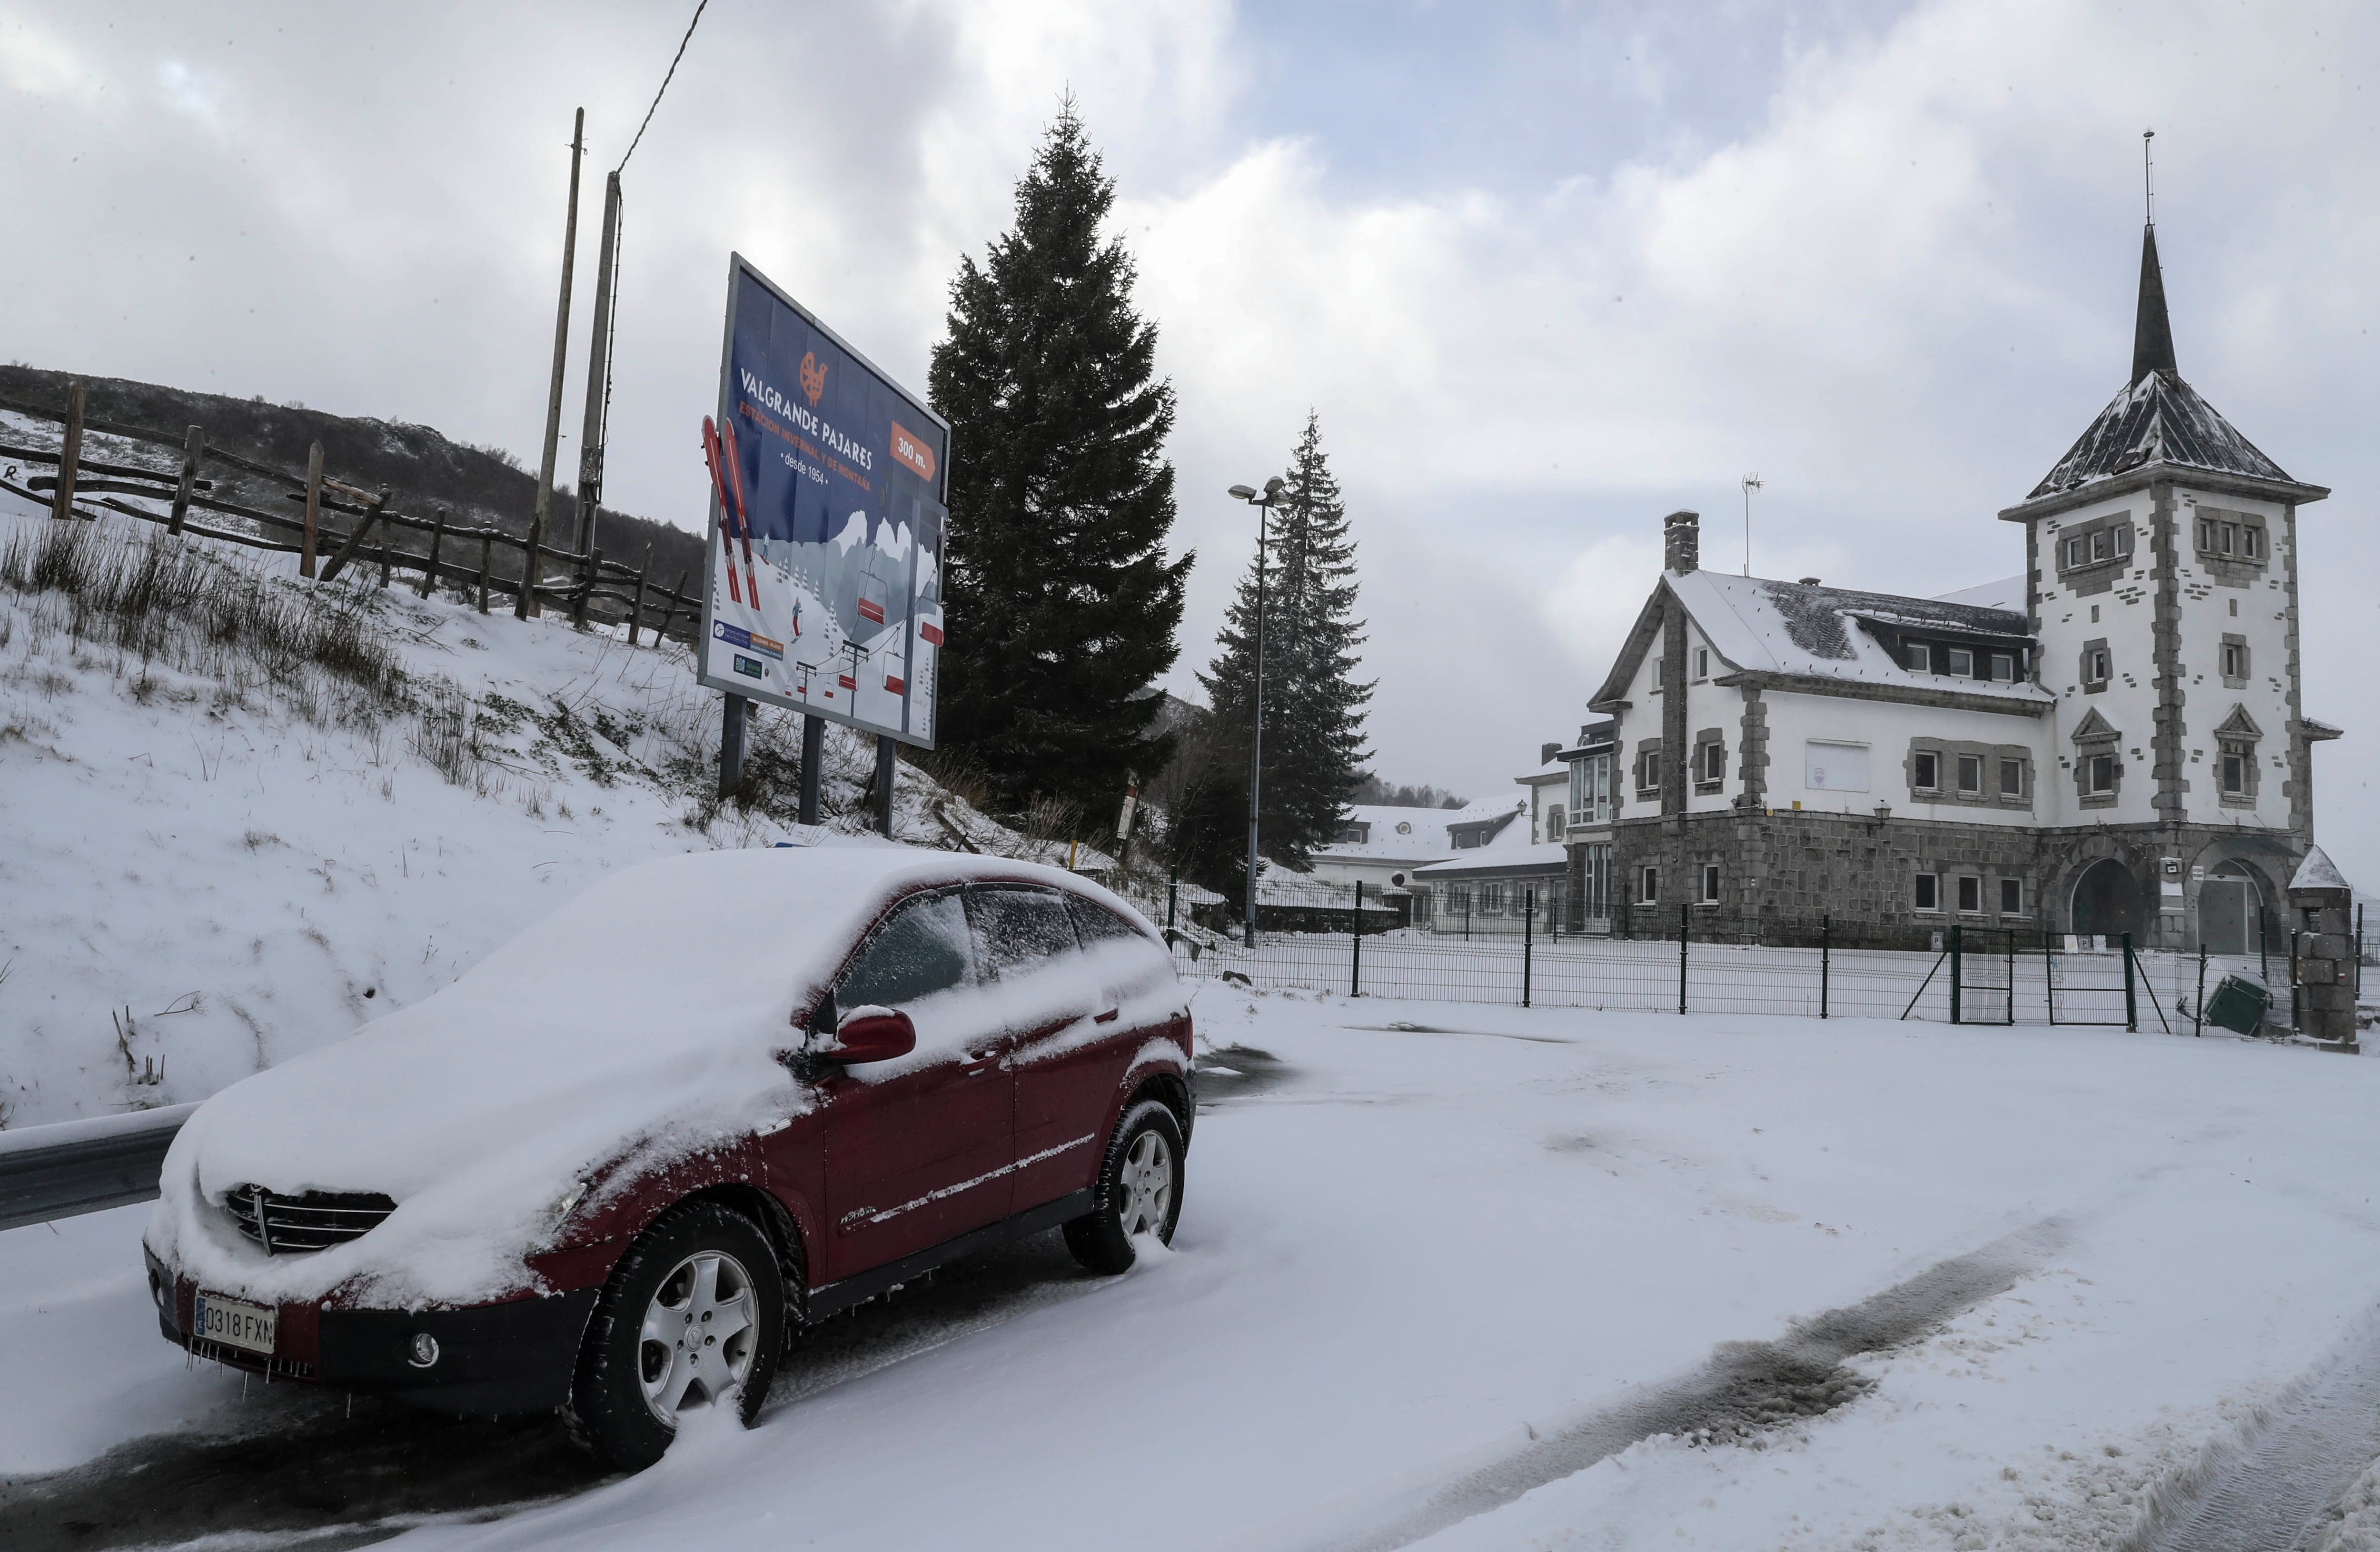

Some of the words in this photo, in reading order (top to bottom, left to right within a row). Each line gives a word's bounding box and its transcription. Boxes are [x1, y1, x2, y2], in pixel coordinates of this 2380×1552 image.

[741, 368, 818, 437] VALGRANDE
[823, 422, 872, 470] PAJARES
[782, 428, 819, 461] INVERNAL
[822, 452, 826, 464] Y
[828, 456, 837, 471] DE
[838, 463, 871, 492] MONTAÑA
[785, 453, 806, 474] desde
[808, 466, 823, 485] 1954
[898, 437, 913, 460] 300
[915, 453, 925, 469] m.
[206, 1307, 240, 1337] 0318
[246, 1316, 272, 1344] FXN
